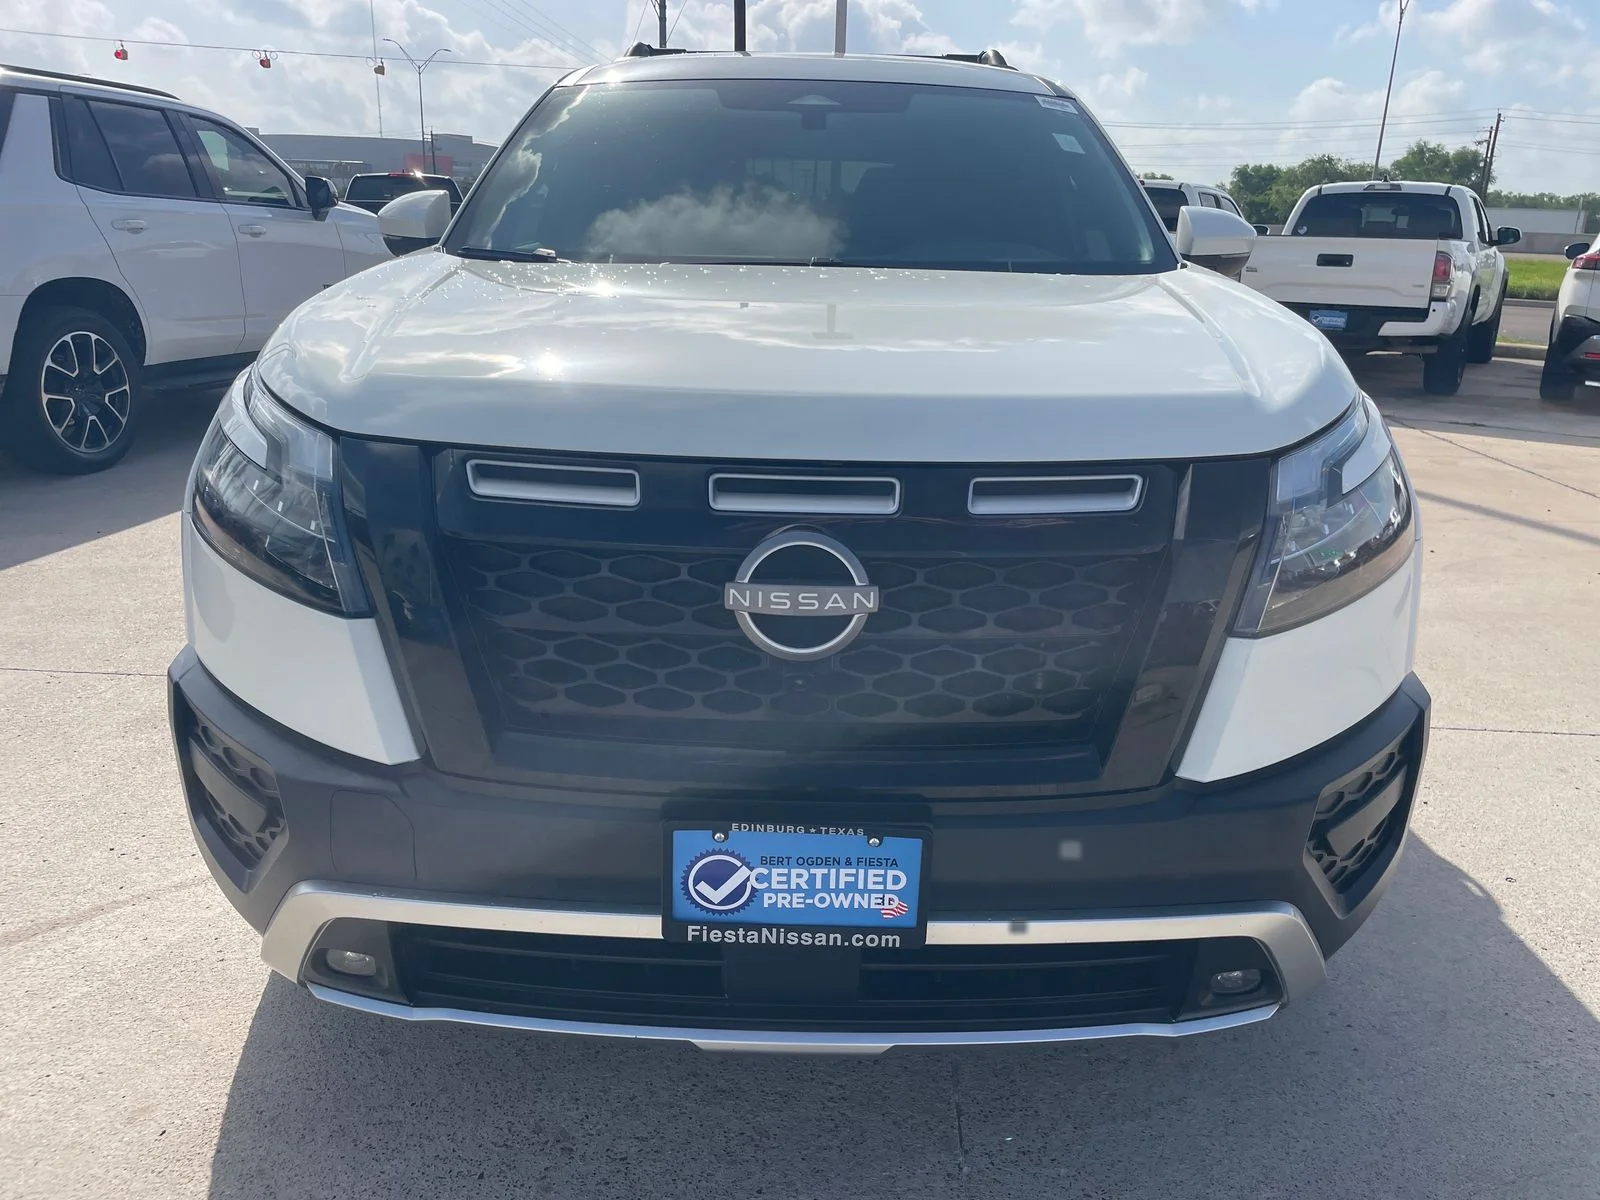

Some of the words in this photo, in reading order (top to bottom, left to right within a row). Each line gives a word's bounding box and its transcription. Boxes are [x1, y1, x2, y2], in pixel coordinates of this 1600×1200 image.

[729, 588, 874, 610] NISSAN
[731, 823, 806, 834] EDINBURG
[820, 826, 865, 836] TEXAS
[760, 855, 793, 866] BERT
[796, 856, 841, 867] OGDEN
[844, 857, 853, 867] &
[856, 857, 899, 868] FIESTA
[750, 867, 908, 891] CERTIFIED
[763, 892, 900, 909] PRE-OWNED
[686, 925, 901, 948] FiestaNissan.com
